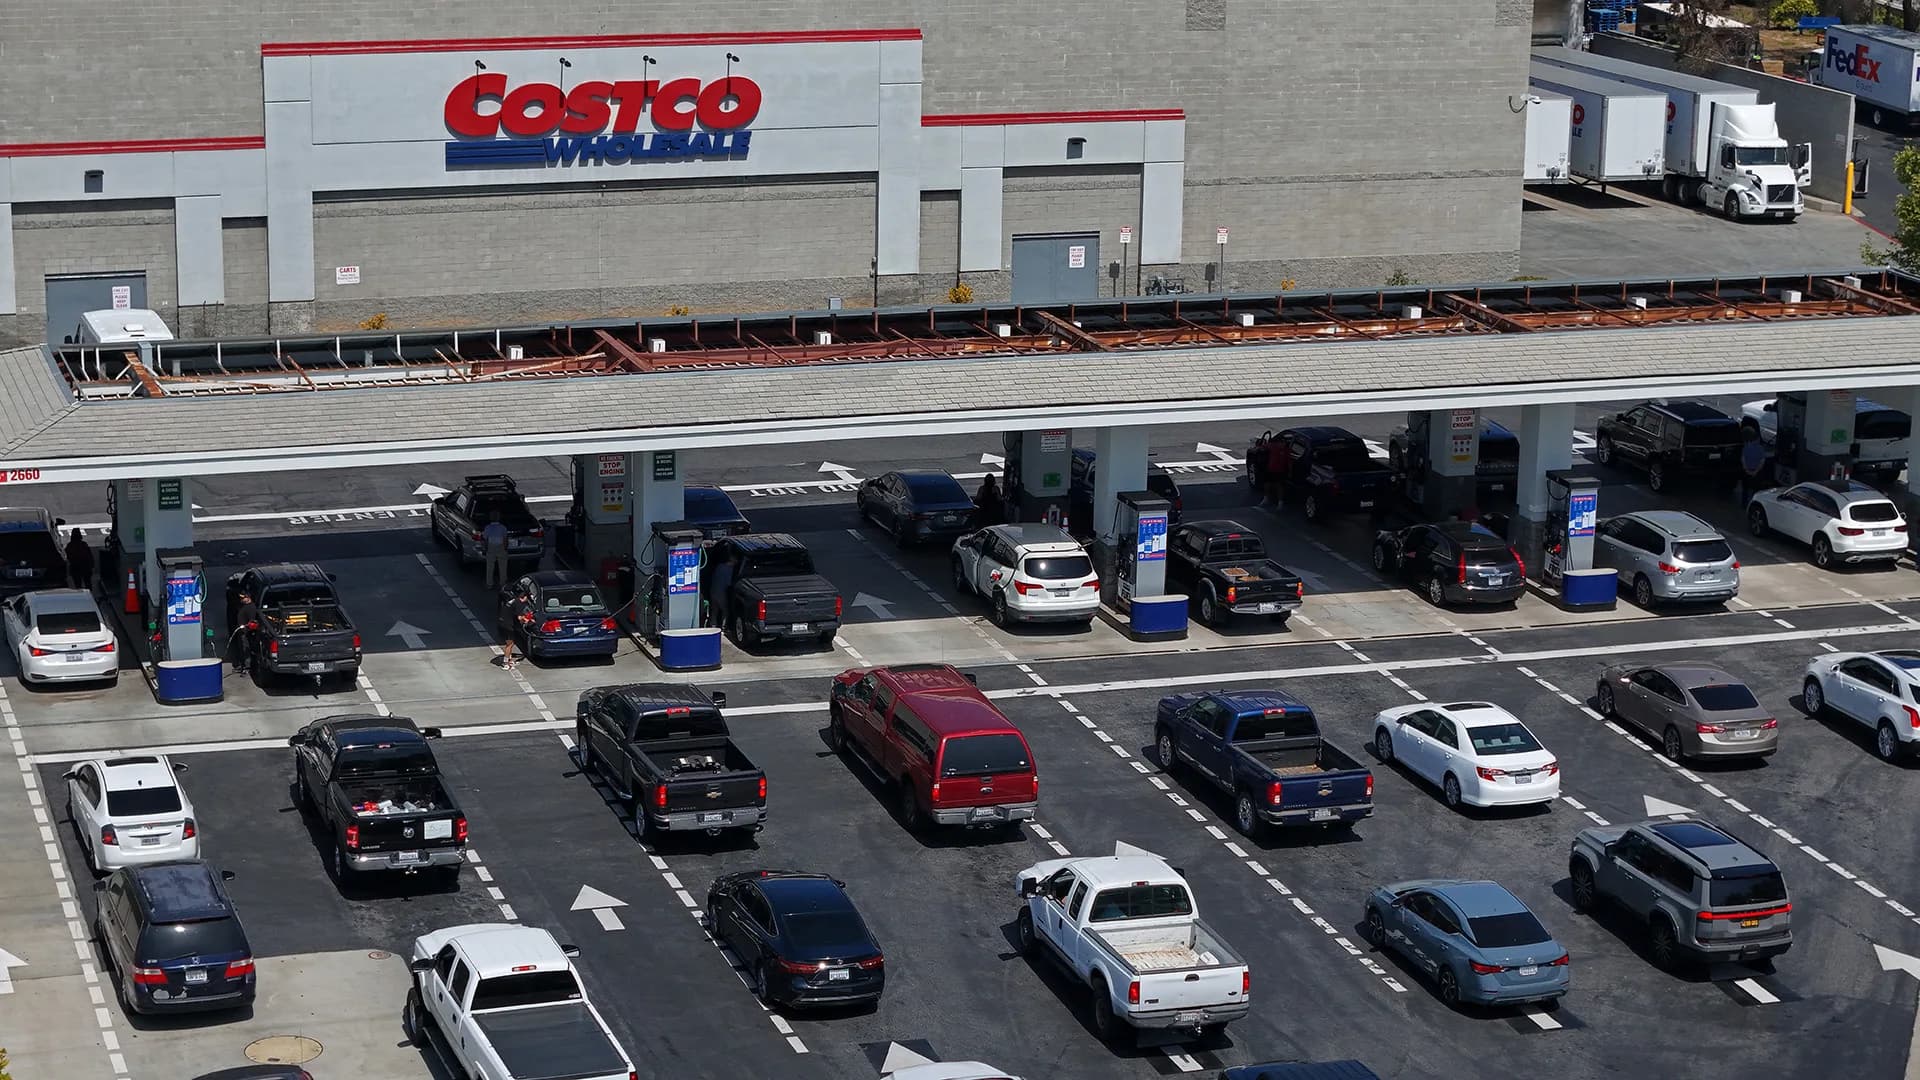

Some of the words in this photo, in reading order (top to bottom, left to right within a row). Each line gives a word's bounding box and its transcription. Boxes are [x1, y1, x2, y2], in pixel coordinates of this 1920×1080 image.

[1826, 36, 1882, 83] FedEx
[444, 73, 762, 138] COSTCO
[544, 131, 752, 165] WHOLESALE
[11, 468, 40, 481] 2660
[750, 487, 808, 497] NOT
[288, 510, 396, 525] ENTER
